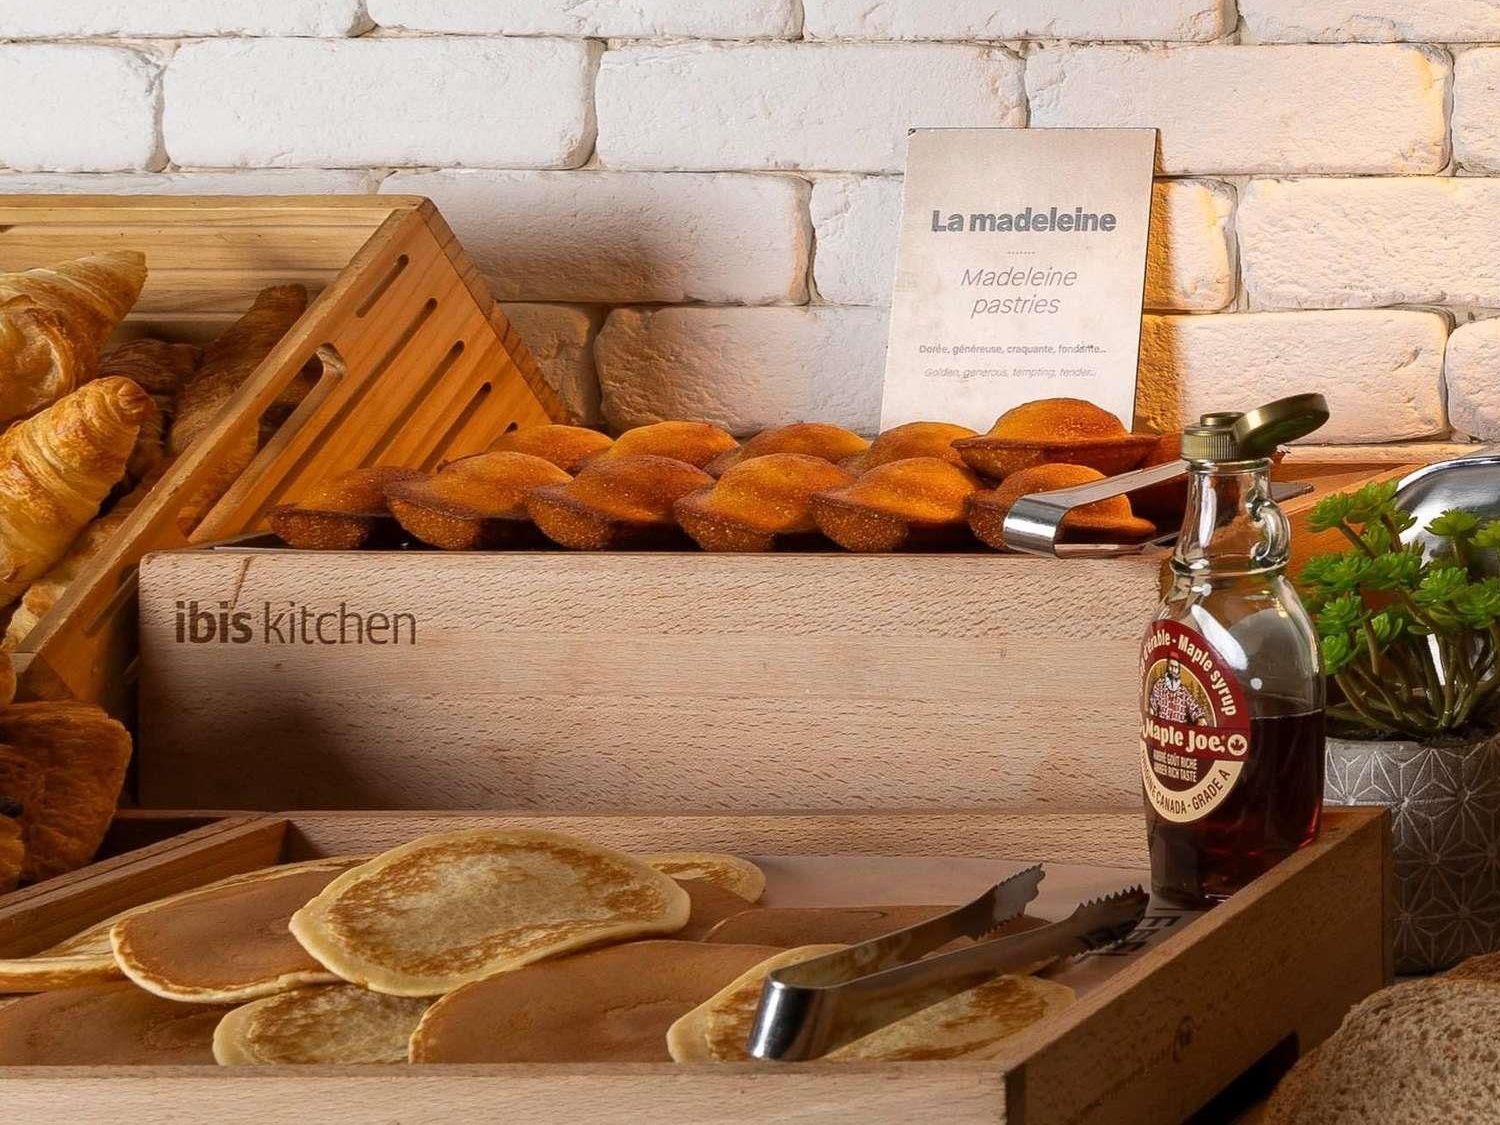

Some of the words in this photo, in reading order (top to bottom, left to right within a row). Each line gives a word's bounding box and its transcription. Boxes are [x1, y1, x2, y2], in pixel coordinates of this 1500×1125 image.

[931, 210, 964, 232] La
[970, 207, 1117, 232] madeleine
[960, 267, 1078, 287] Madeleine
[970, 294, 1062, 319] pastries
[176, 601, 253, 643] ibis
[264, 601, 417, 645] kitchen
[1178, 634, 1212, 671] Maple
[1211, 670, 1237, 716] syrup
[1140, 718, 1184, 747] Maple
[1156, 791, 1187, 815] CANADA
[1192, 780, 1224, 812] GRADE
[1220, 769, 1231, 781] A
